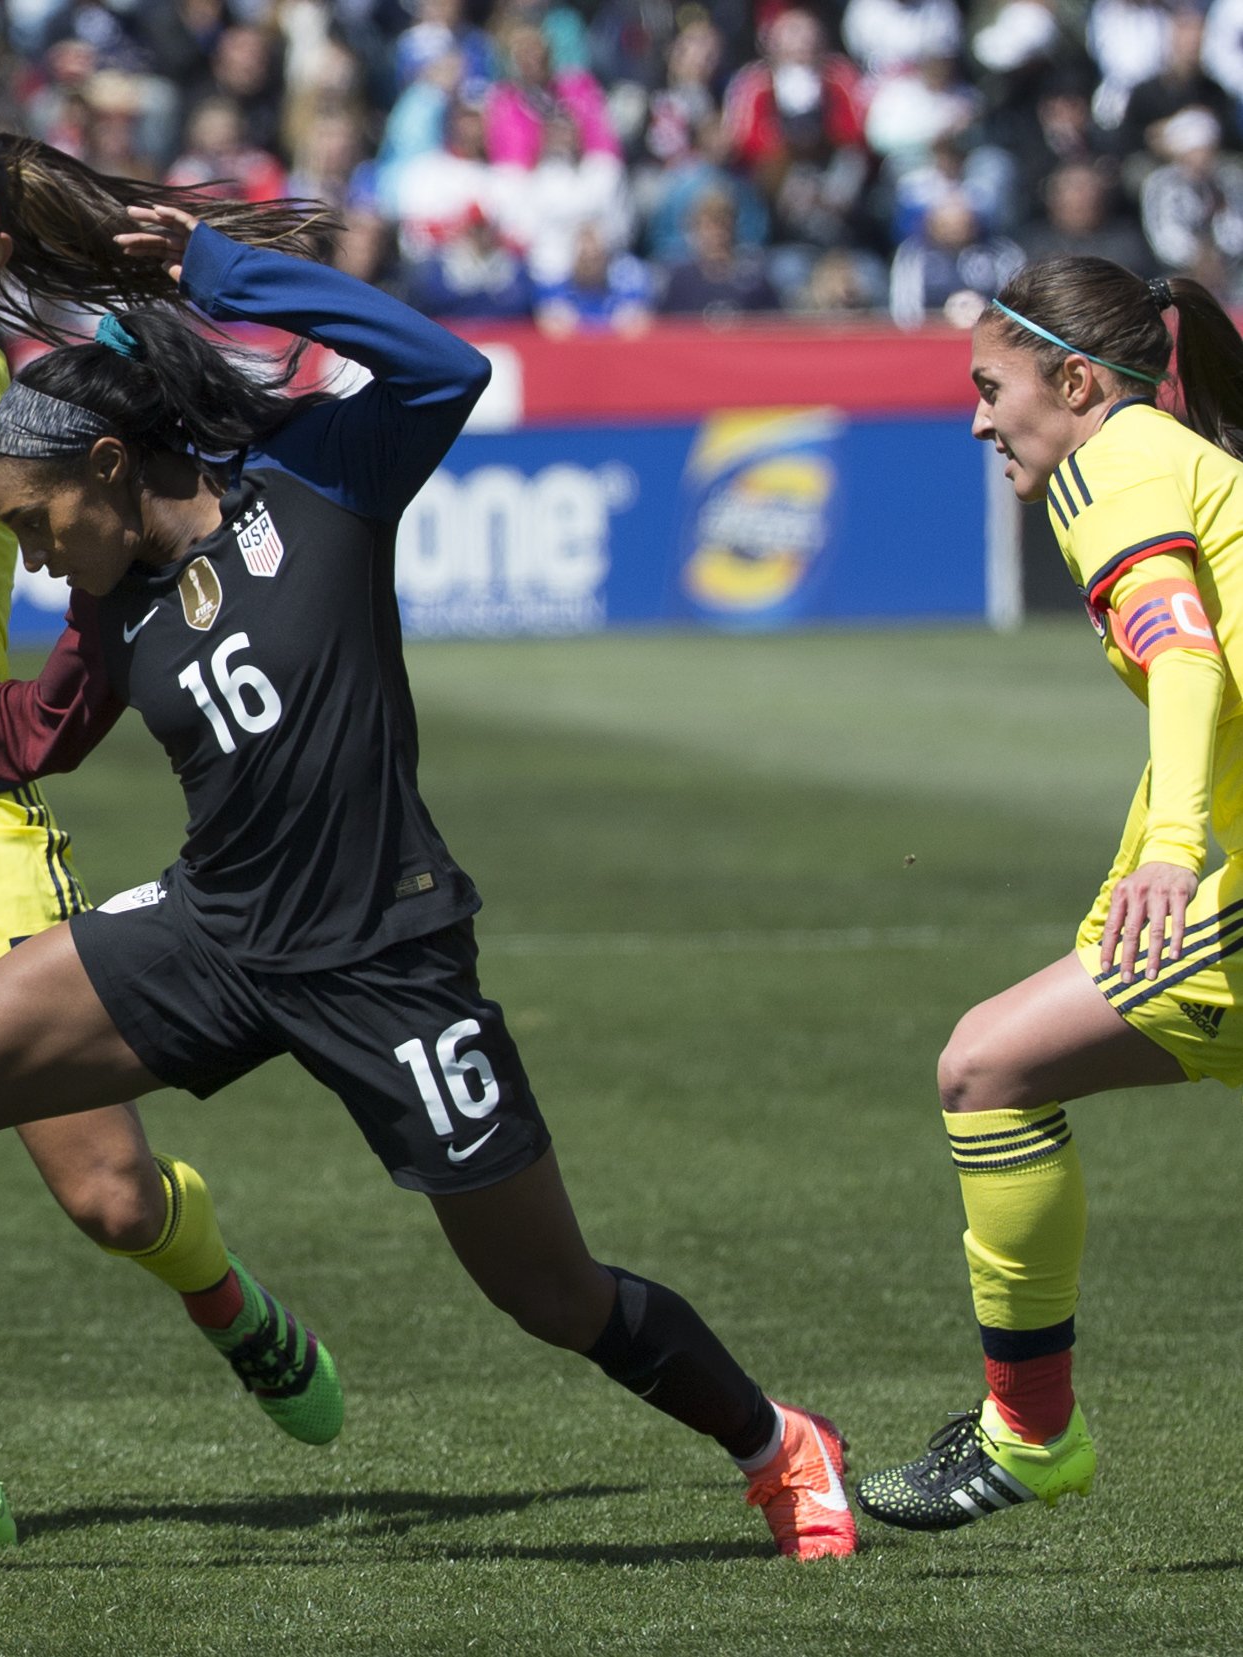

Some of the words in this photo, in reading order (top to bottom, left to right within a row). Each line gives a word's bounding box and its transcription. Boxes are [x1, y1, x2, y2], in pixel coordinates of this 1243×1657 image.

[241, 517, 270, 549] USA
[178, 632, 282, 754] 16
[1179, 1002, 1218, 1039] adidas
[394, 1018, 500, 1136] 16
